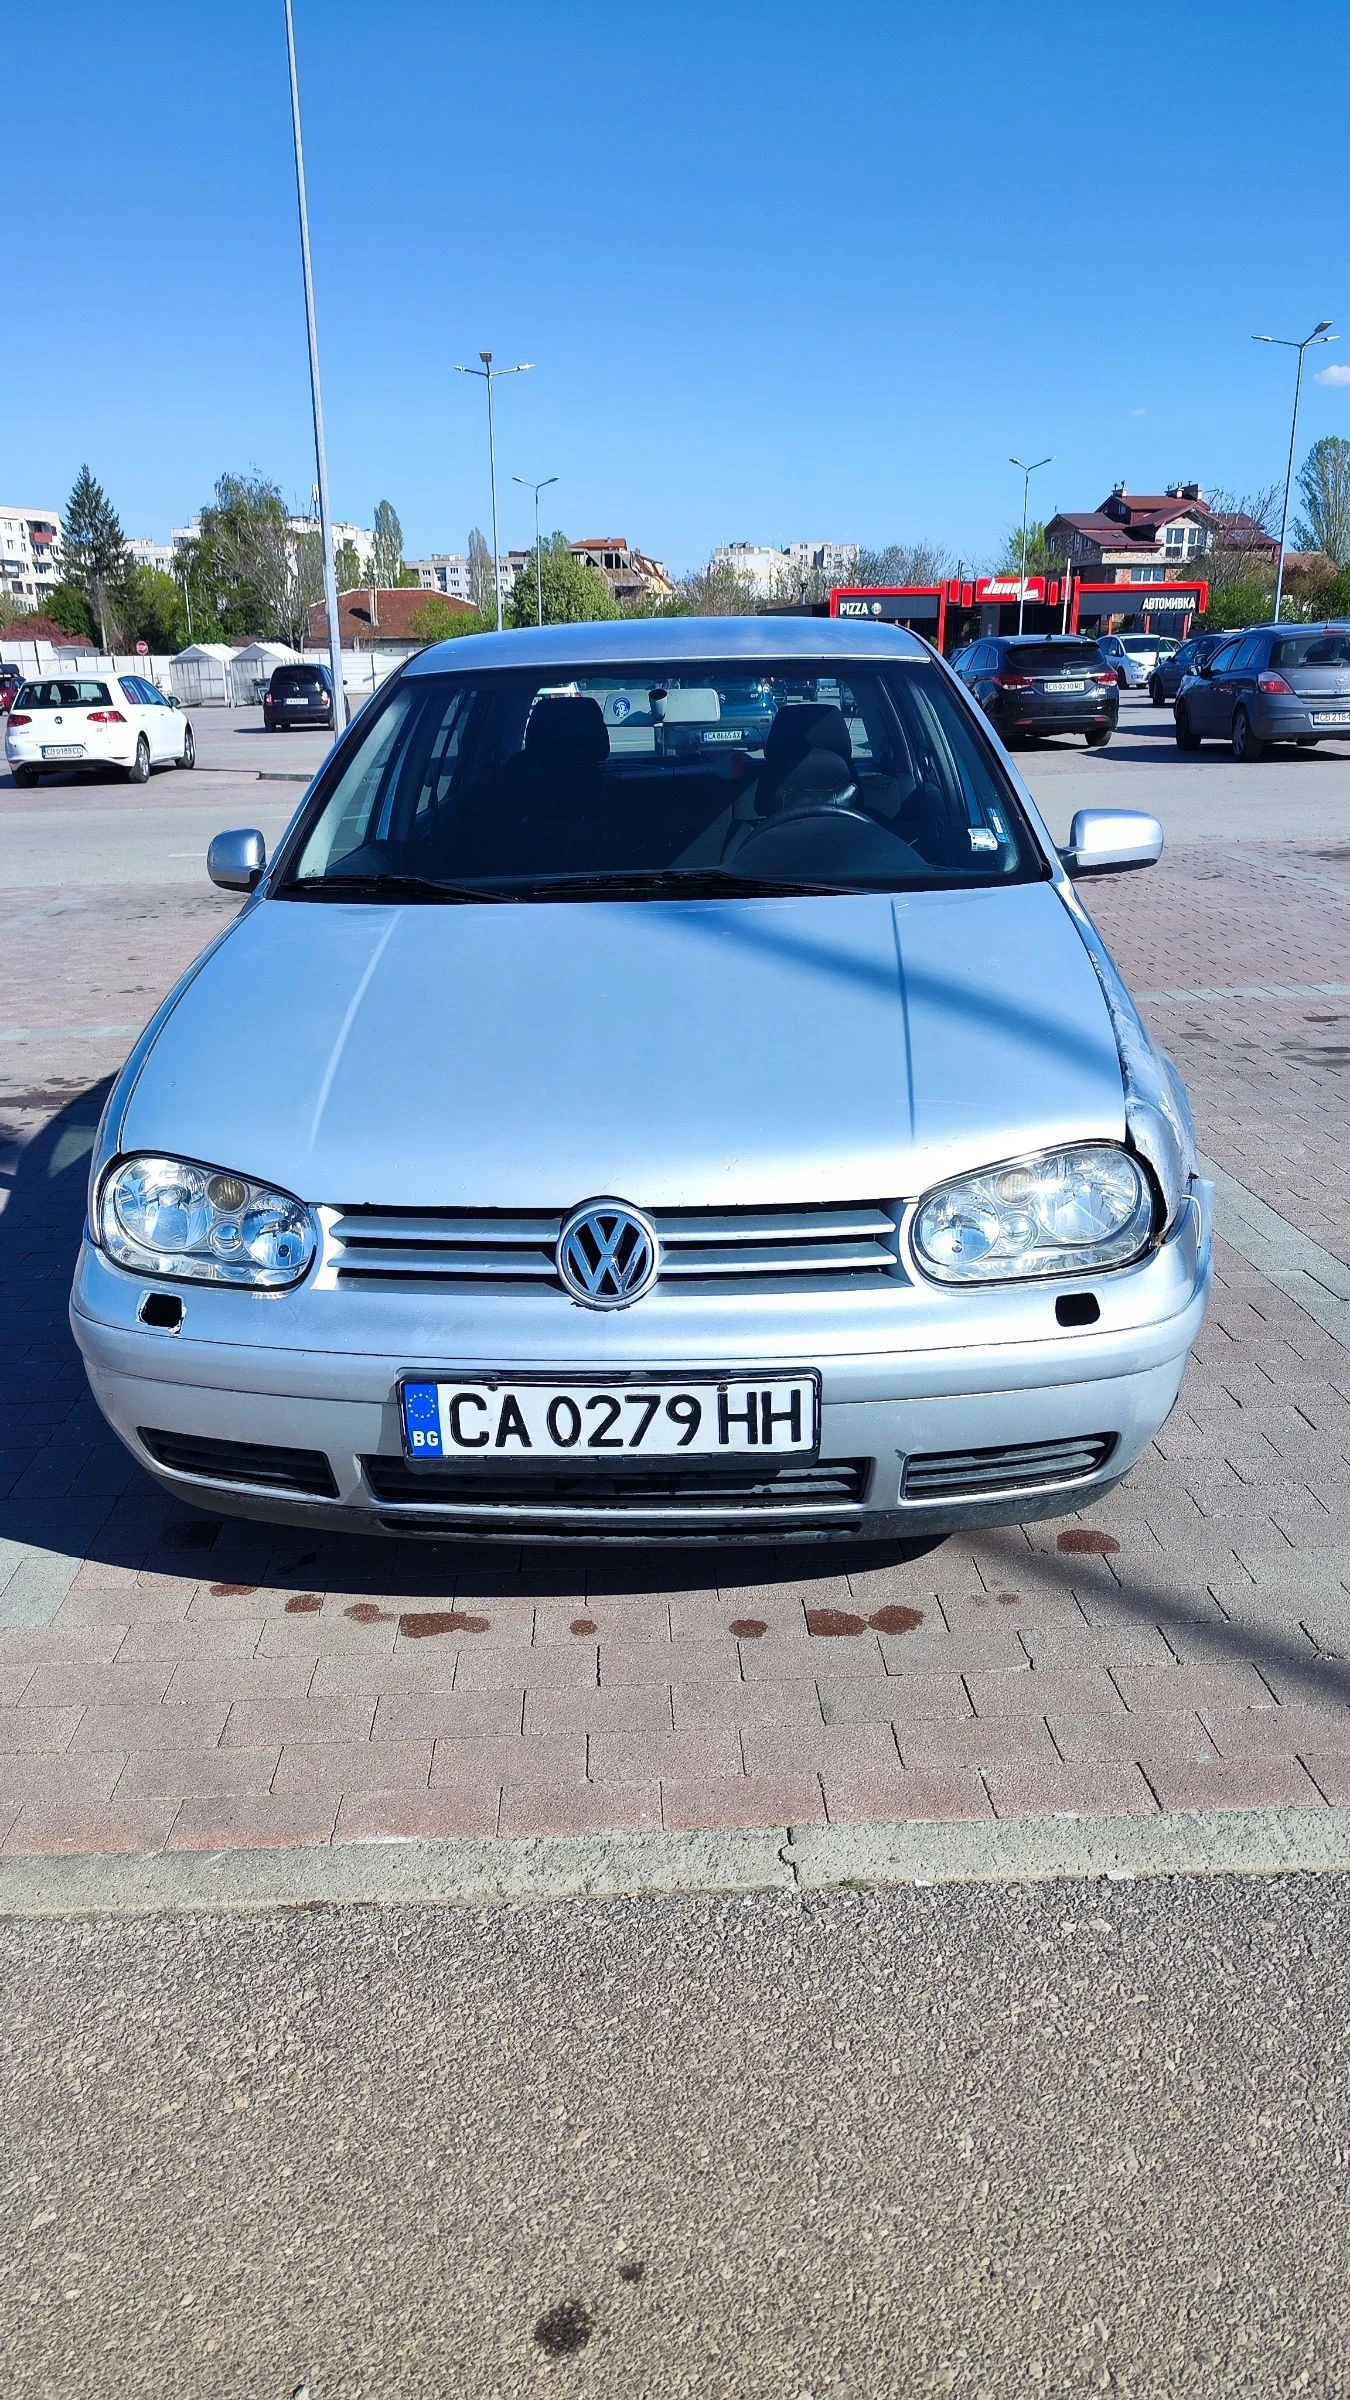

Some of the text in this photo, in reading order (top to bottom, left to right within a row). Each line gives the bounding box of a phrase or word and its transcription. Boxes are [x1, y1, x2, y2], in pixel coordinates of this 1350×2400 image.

[840, 602, 869, 615] PIZZA
[1142, 597, 1196, 610] АВТОМИВКА
[449, 1389, 801, 1448] CA 0279 HH
[412, 1430, 439, 1447] BG
